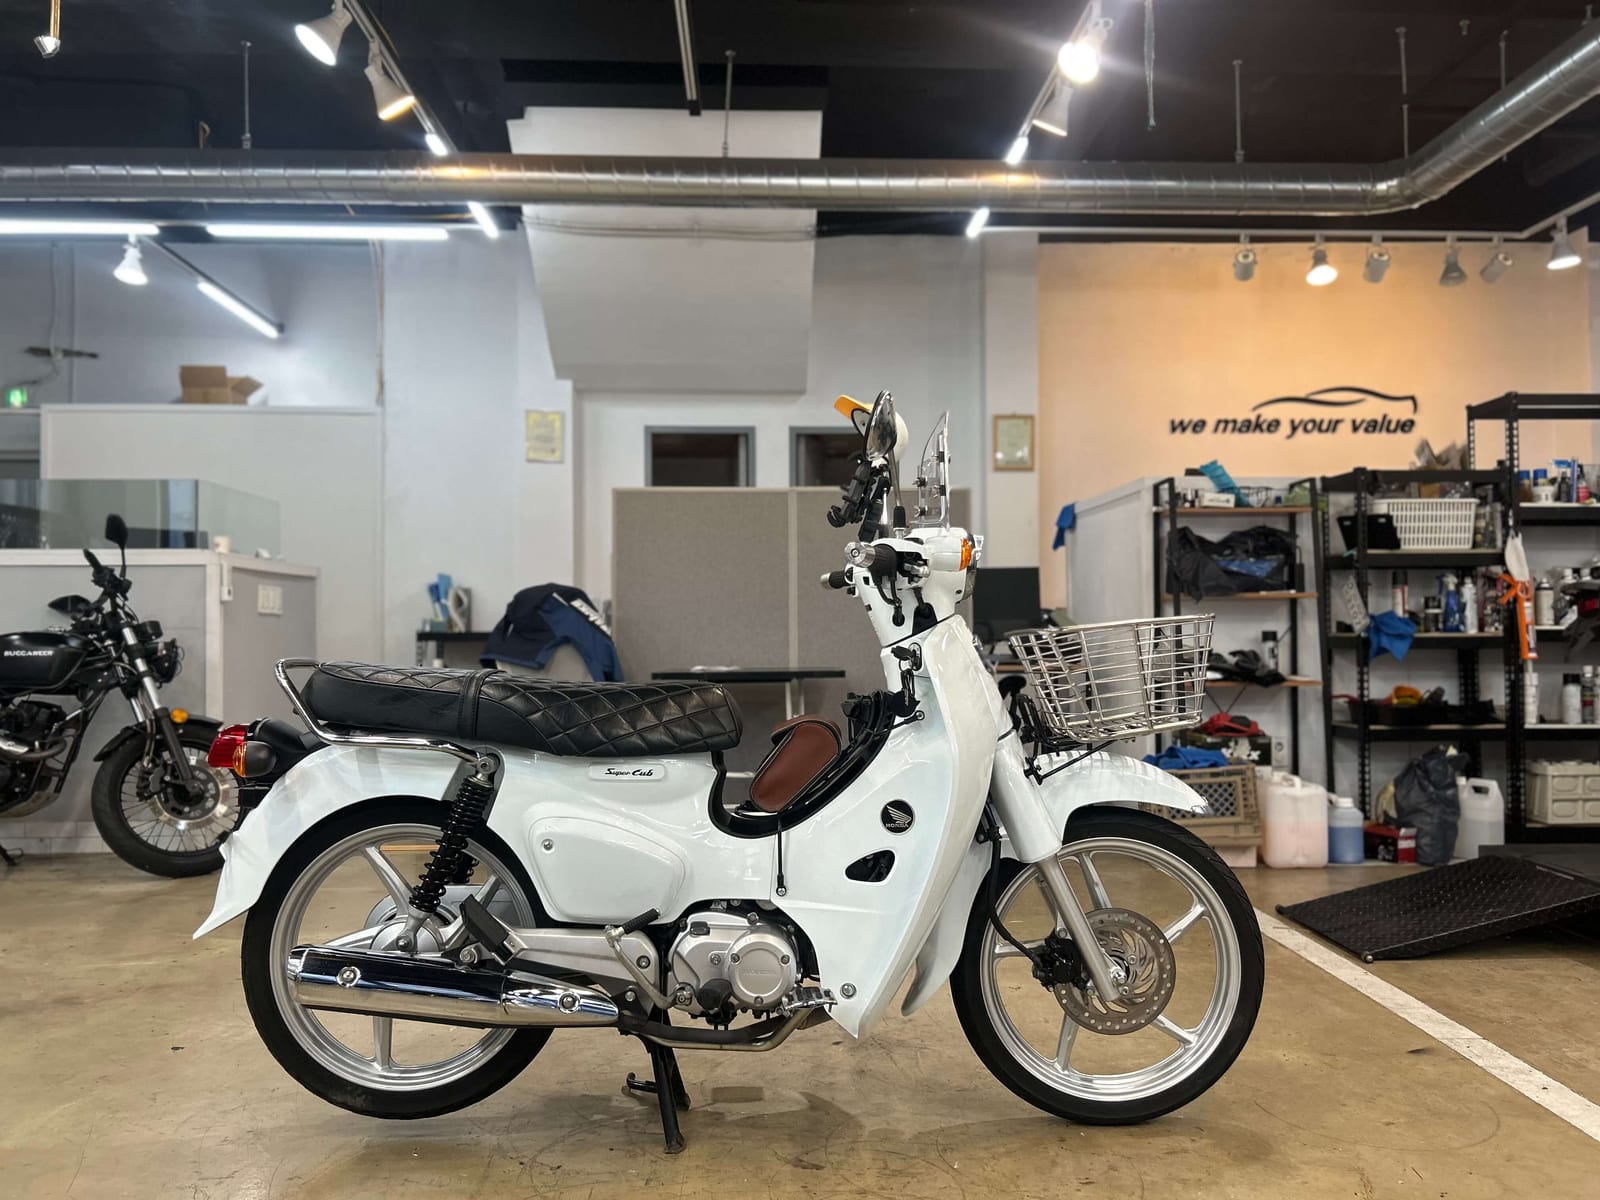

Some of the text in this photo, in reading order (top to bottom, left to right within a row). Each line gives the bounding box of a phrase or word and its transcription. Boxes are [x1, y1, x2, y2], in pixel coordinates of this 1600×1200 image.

[1170, 413, 1416, 440] we make your value
[605, 767, 654, 777] Super Cub
